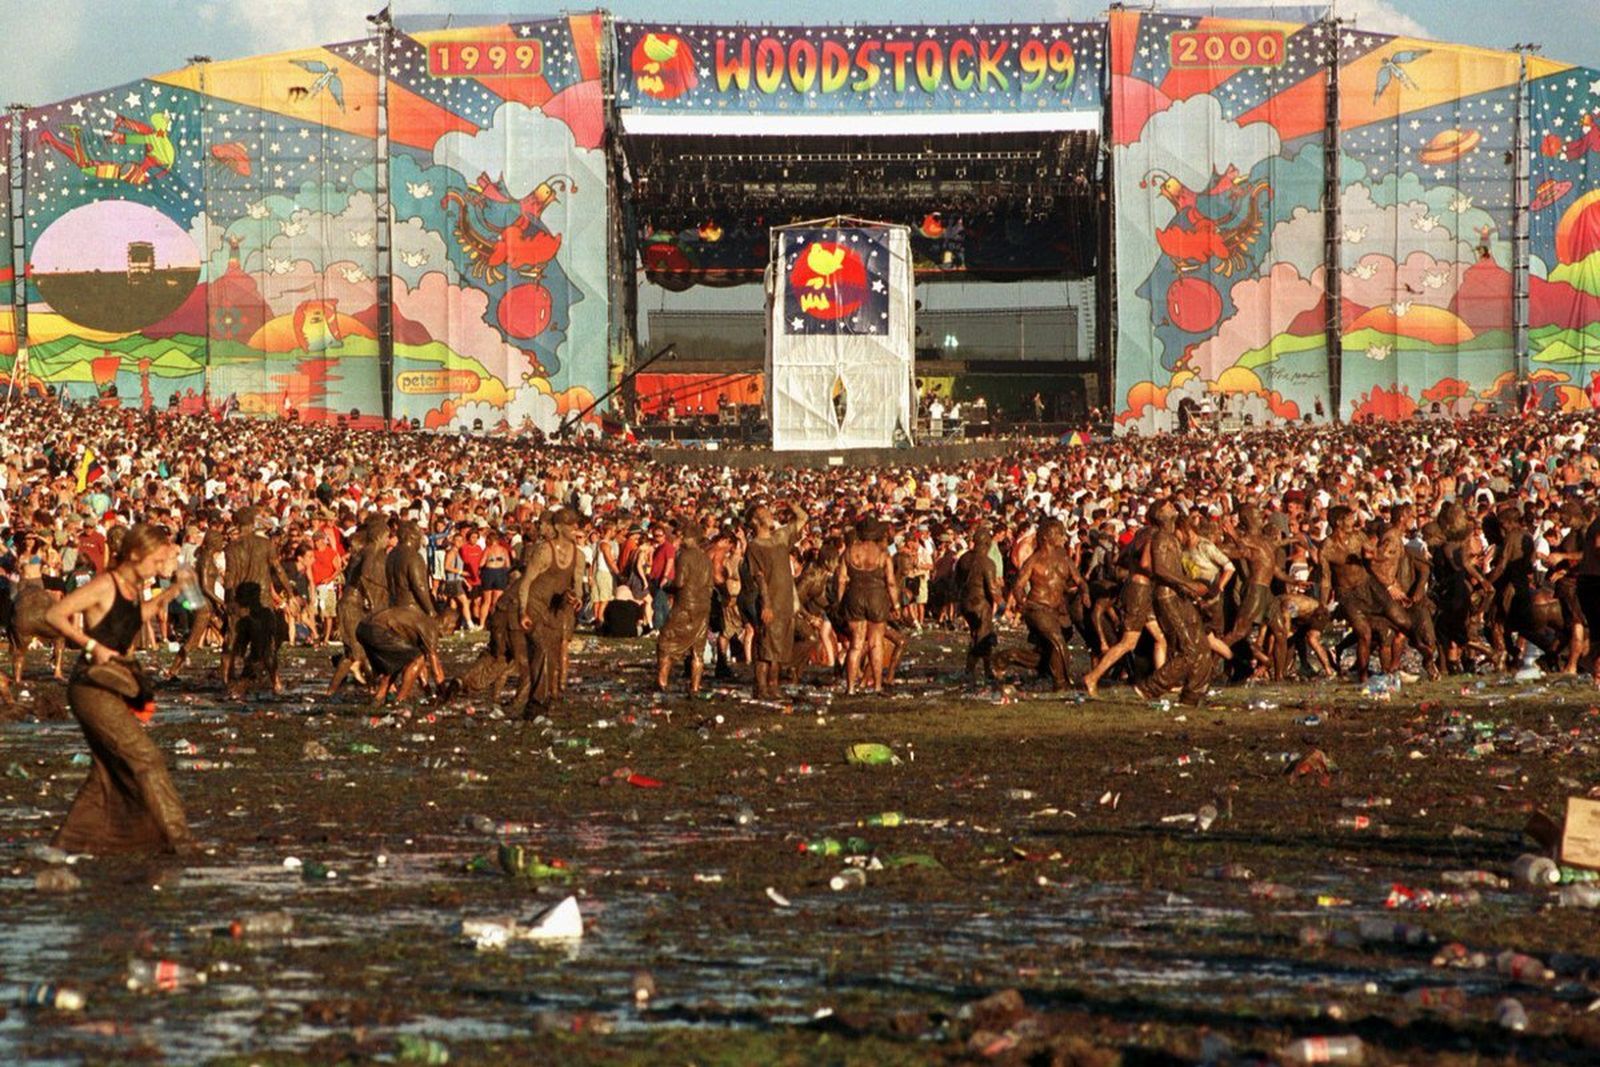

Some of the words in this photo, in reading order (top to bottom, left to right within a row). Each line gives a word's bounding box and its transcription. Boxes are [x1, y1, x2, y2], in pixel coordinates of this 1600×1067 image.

[438, 46, 534, 70] 1999
[1179, 35, 1277, 62] 2000
[715, 37, 1009, 93] WOODSTOCK
[1019, 39, 1075, 92] 99
[403, 374, 438, 390] peter
